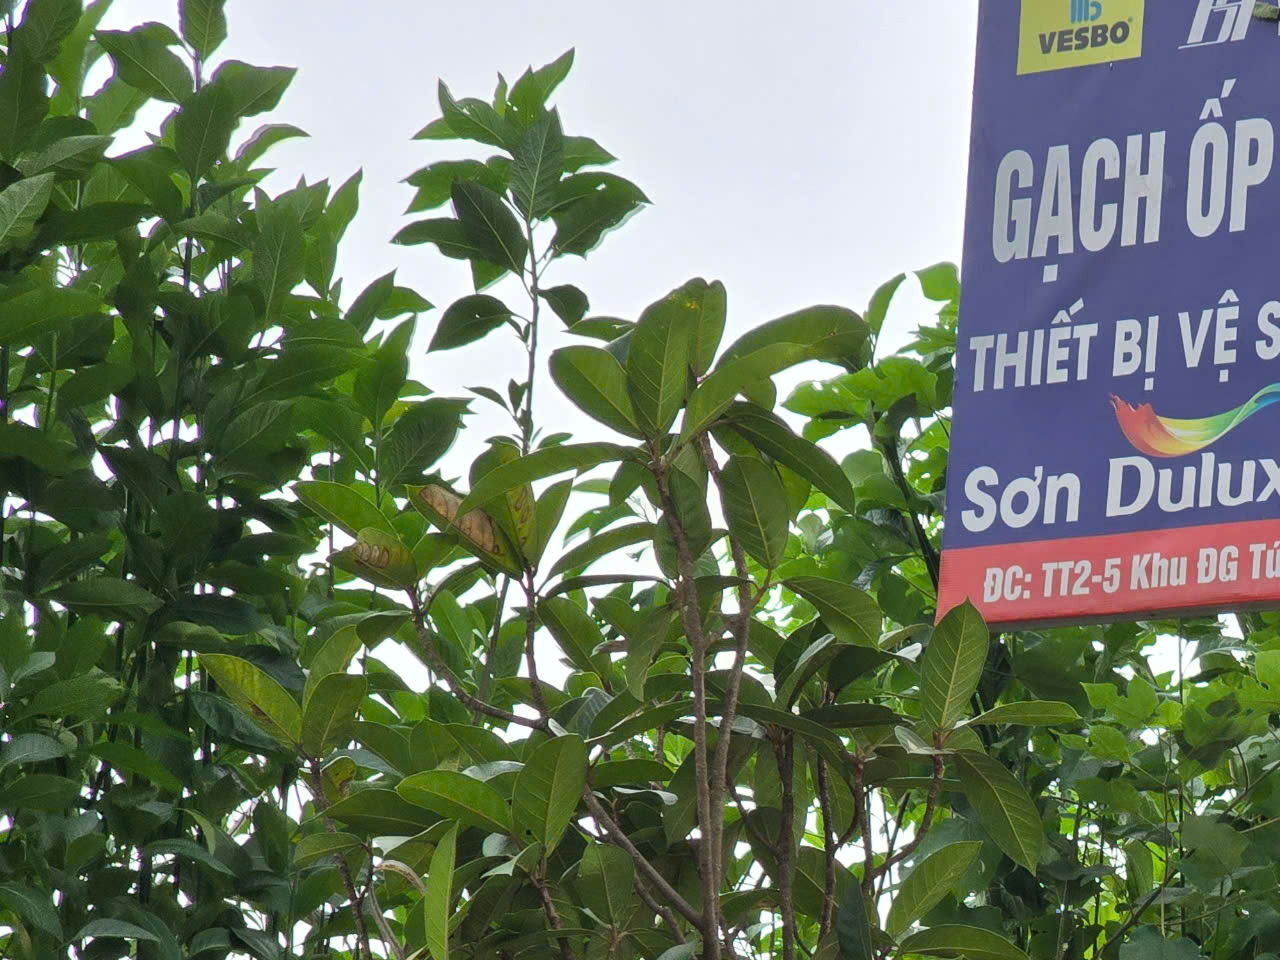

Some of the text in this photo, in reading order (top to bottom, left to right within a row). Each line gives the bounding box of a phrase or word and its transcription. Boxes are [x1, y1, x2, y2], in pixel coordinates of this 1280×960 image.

[1038, 20, 1130, 55] VESBO
[992, 130, 1167, 283] GẠCH
[1186, 78, 1275, 238] ỐP
[969, 297, 1098, 392] THIẾT
[1112, 315, 1159, 391] BỊ
[1178, 289, 1240, 382] VỆ
[961, 465, 1081, 532] Sơn
[983, 566, 1032, 603] ĐC:
[1042, 557, 1121, 598] TT2-5
[1130, 552, 1187, 590] Khu
[1197, 545, 1239, 584] ĐG
